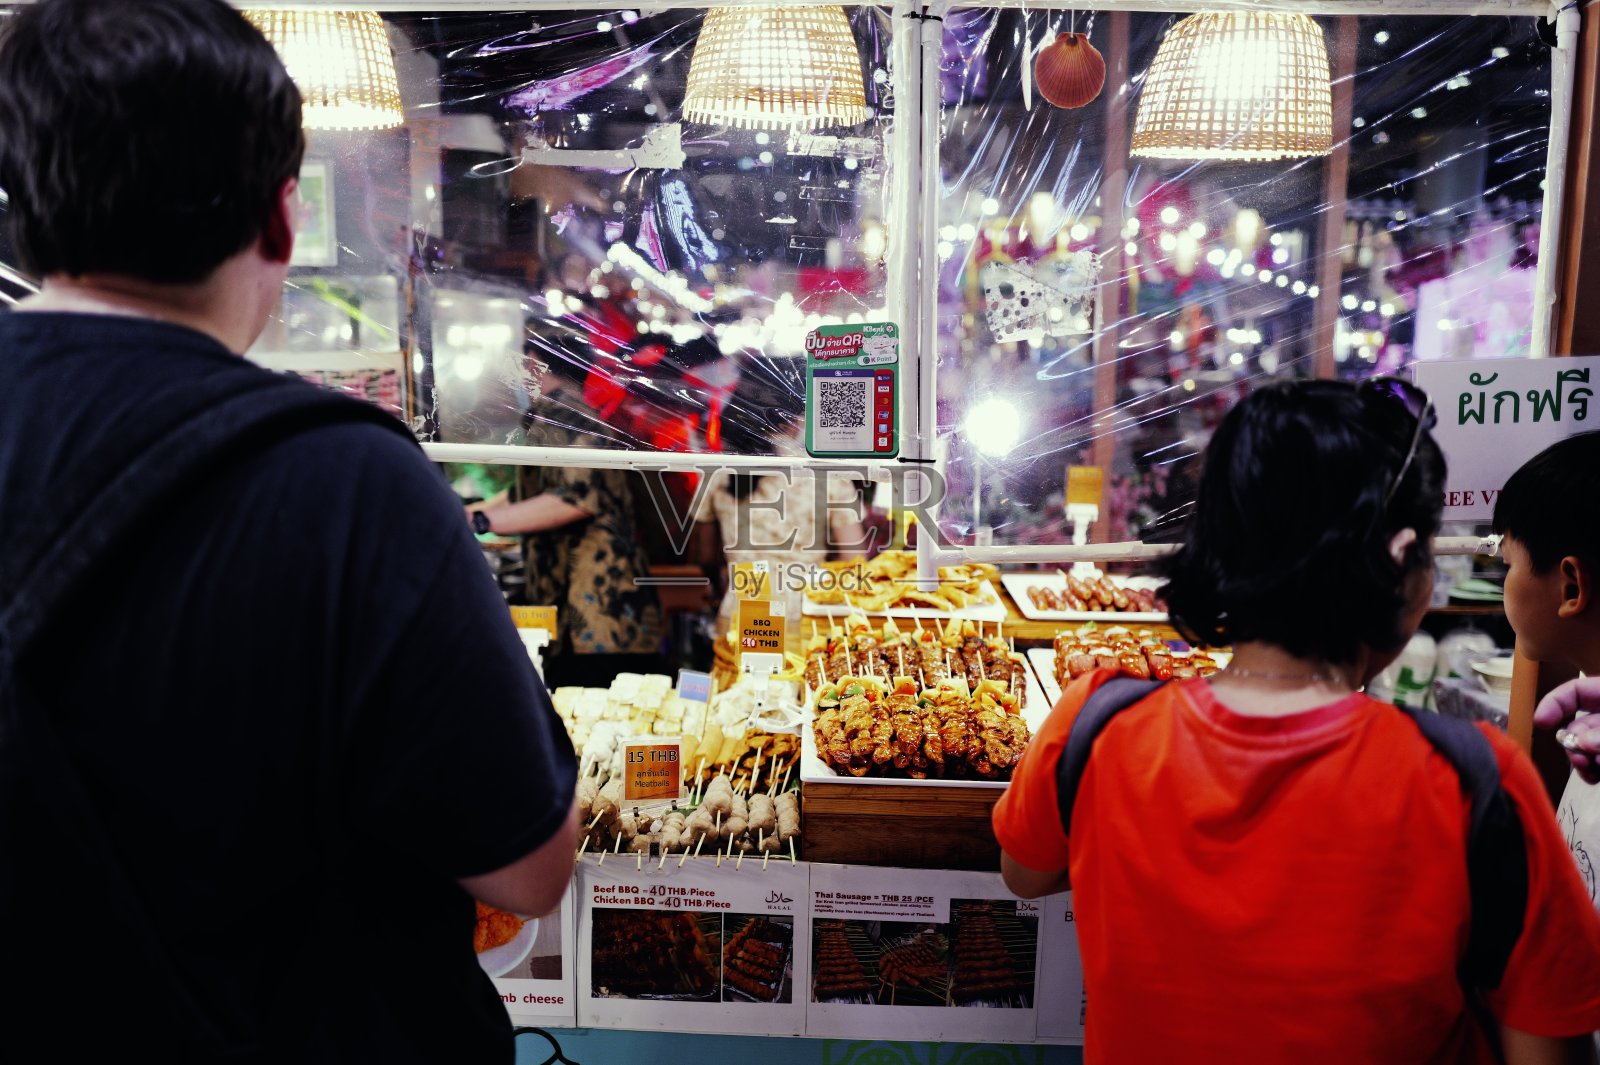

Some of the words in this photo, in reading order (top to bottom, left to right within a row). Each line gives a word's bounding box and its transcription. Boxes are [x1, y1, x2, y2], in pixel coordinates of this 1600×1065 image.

[842, 334, 861, 346] QR
[1458, 368, 1594, 425] ผักฟรี
[753, 619, 771, 627] BBQ
[743, 629, 780, 637] CHICKEN
[742, 638, 756, 648] 40
[758, 639, 779, 648] THB
[629, 751, 645, 763] 15
[650, 750, 678, 762] THB
[635, 779, 670, 787] Meatballs
[593, 885, 616, 894] Beef
[618, 886, 639, 895] BBQ
[593, 895, 631, 905] Chicken
[634, 897, 655, 906] BBQ
[765, 890, 794, 903] حلال
[836, 893, 871, 901] Sausage
[881, 894, 899, 902] THB
[523, 993, 564, 1004] cheese
